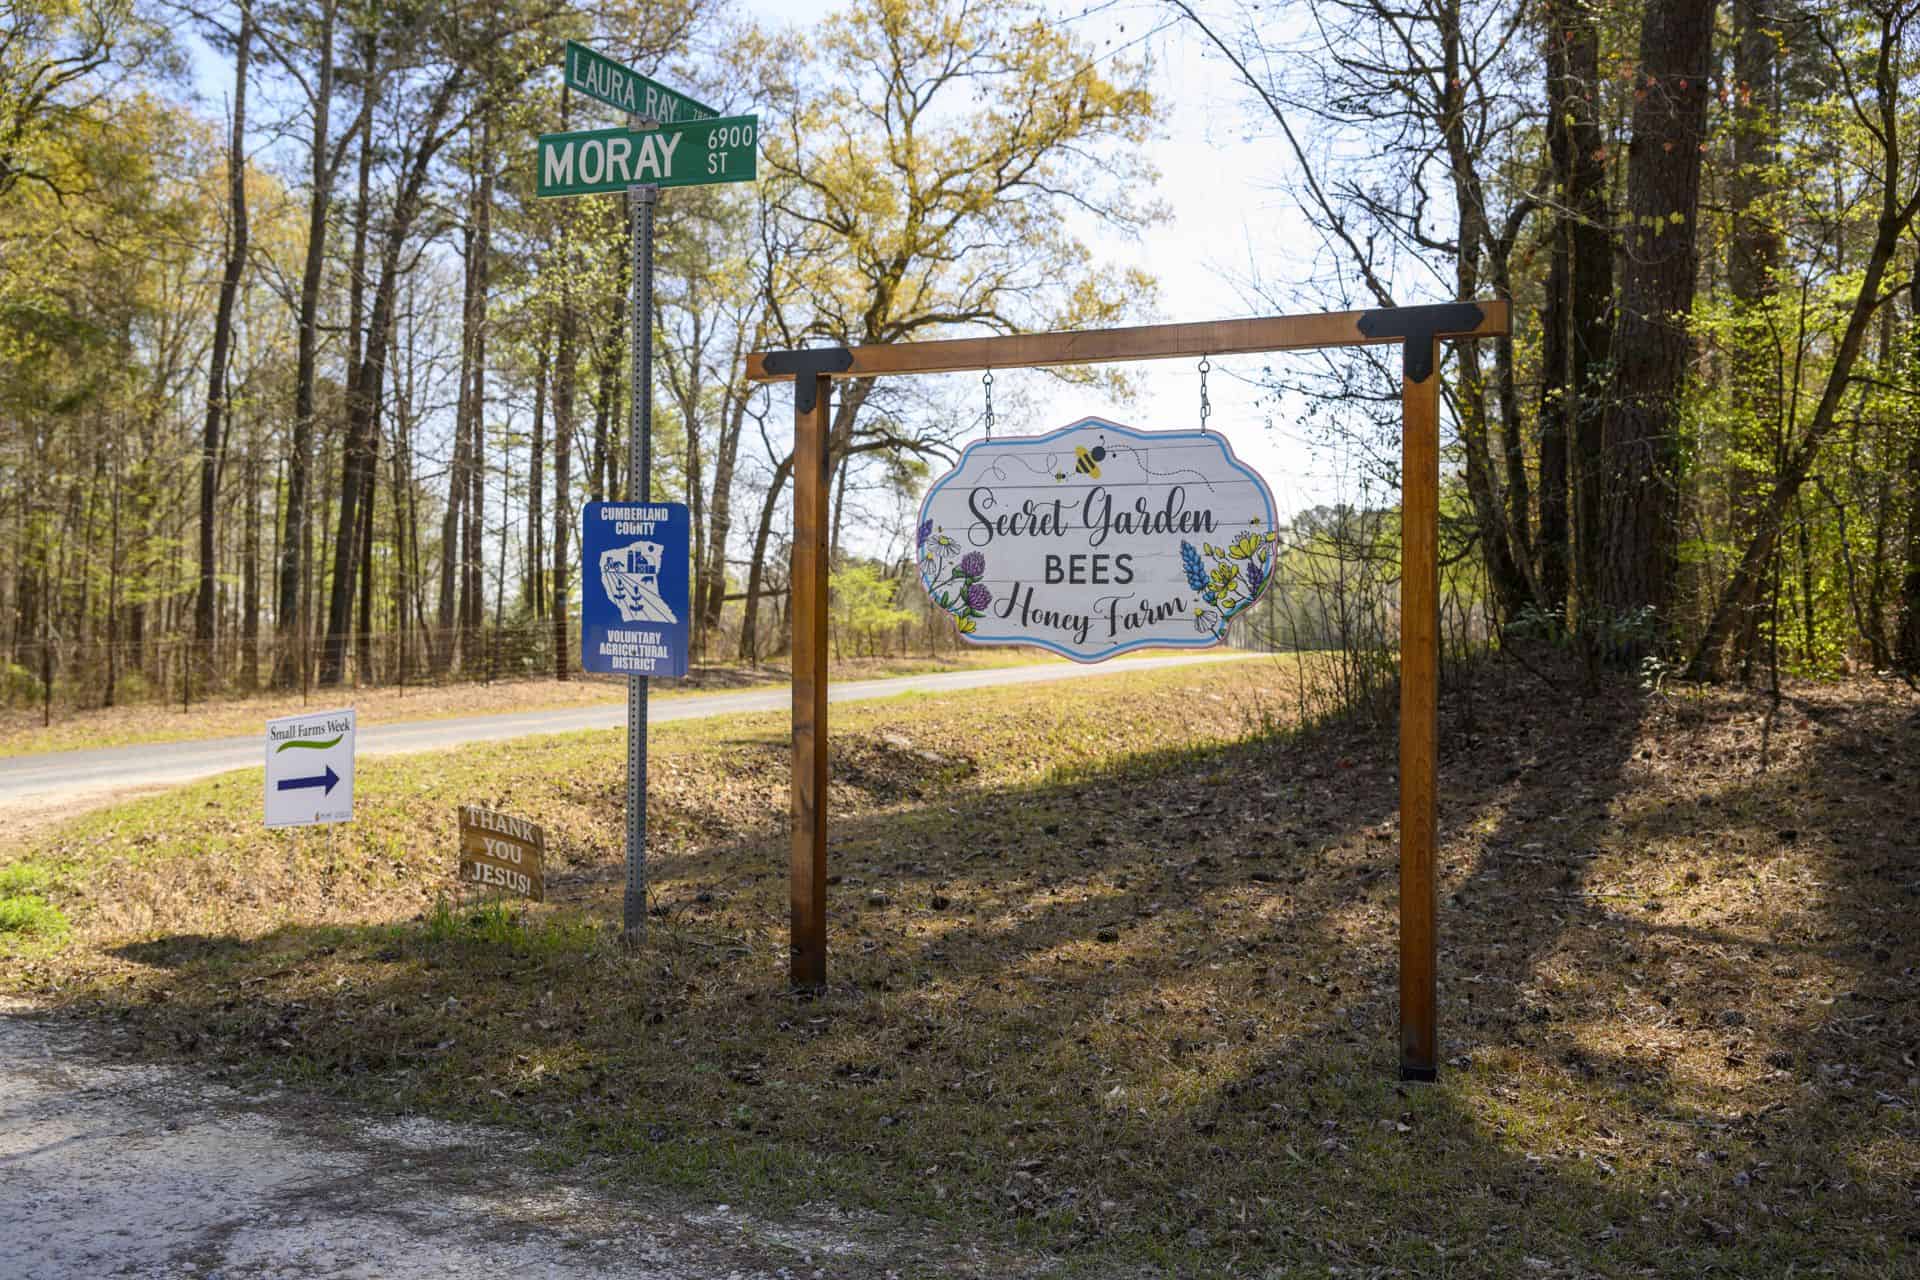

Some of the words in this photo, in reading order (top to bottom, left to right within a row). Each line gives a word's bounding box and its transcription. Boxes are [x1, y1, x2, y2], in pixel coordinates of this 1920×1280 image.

[572, 52, 636, 110] LAURA
[645, 86, 679, 123] RAY
[707, 125, 753, 149] 6900
[544, 132, 683, 187] MORAY
[707, 152, 729, 175] ST
[601, 507, 669, 521] CUMBERLAND
[968, 486, 1079, 547] Secret
[1082, 486, 1219, 547] Garden
[615, 522, 656, 536] COUNTY
[1045, 554, 1135, 585] BEES
[993, 581, 1094, 645] Honey
[1092, 592, 1187, 637] Farm
[600, 642, 669, 659] AGRICULTURAL
[607, 630, 662, 645] VOLUNTARY
[612, 657, 657, 671] DISTRICT
[270, 724, 296, 741] Small
[298, 723, 326, 738] Farms
[327, 716, 351, 733] Week
[466, 806, 535, 843] THANK
[483, 837, 523, 865] YOU
[471, 862, 532, 897] JESUS!
